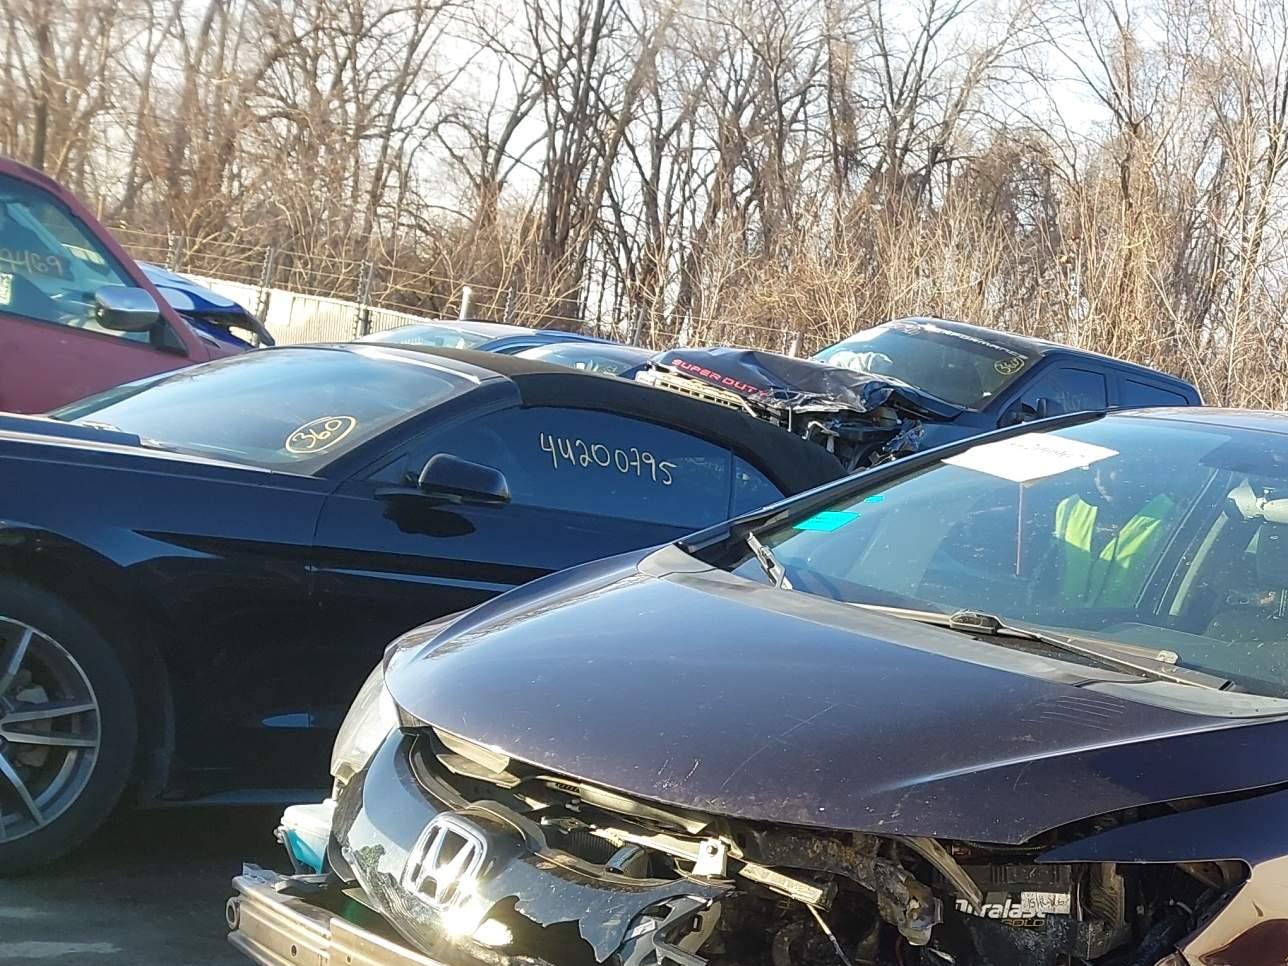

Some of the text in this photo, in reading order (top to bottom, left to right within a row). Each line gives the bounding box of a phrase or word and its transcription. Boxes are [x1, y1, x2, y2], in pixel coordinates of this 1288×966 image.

[671, 359, 769, 397] SUPER DUTY
[291, 419, 343, 449] 360
[540, 432, 678, 486] 44200795
